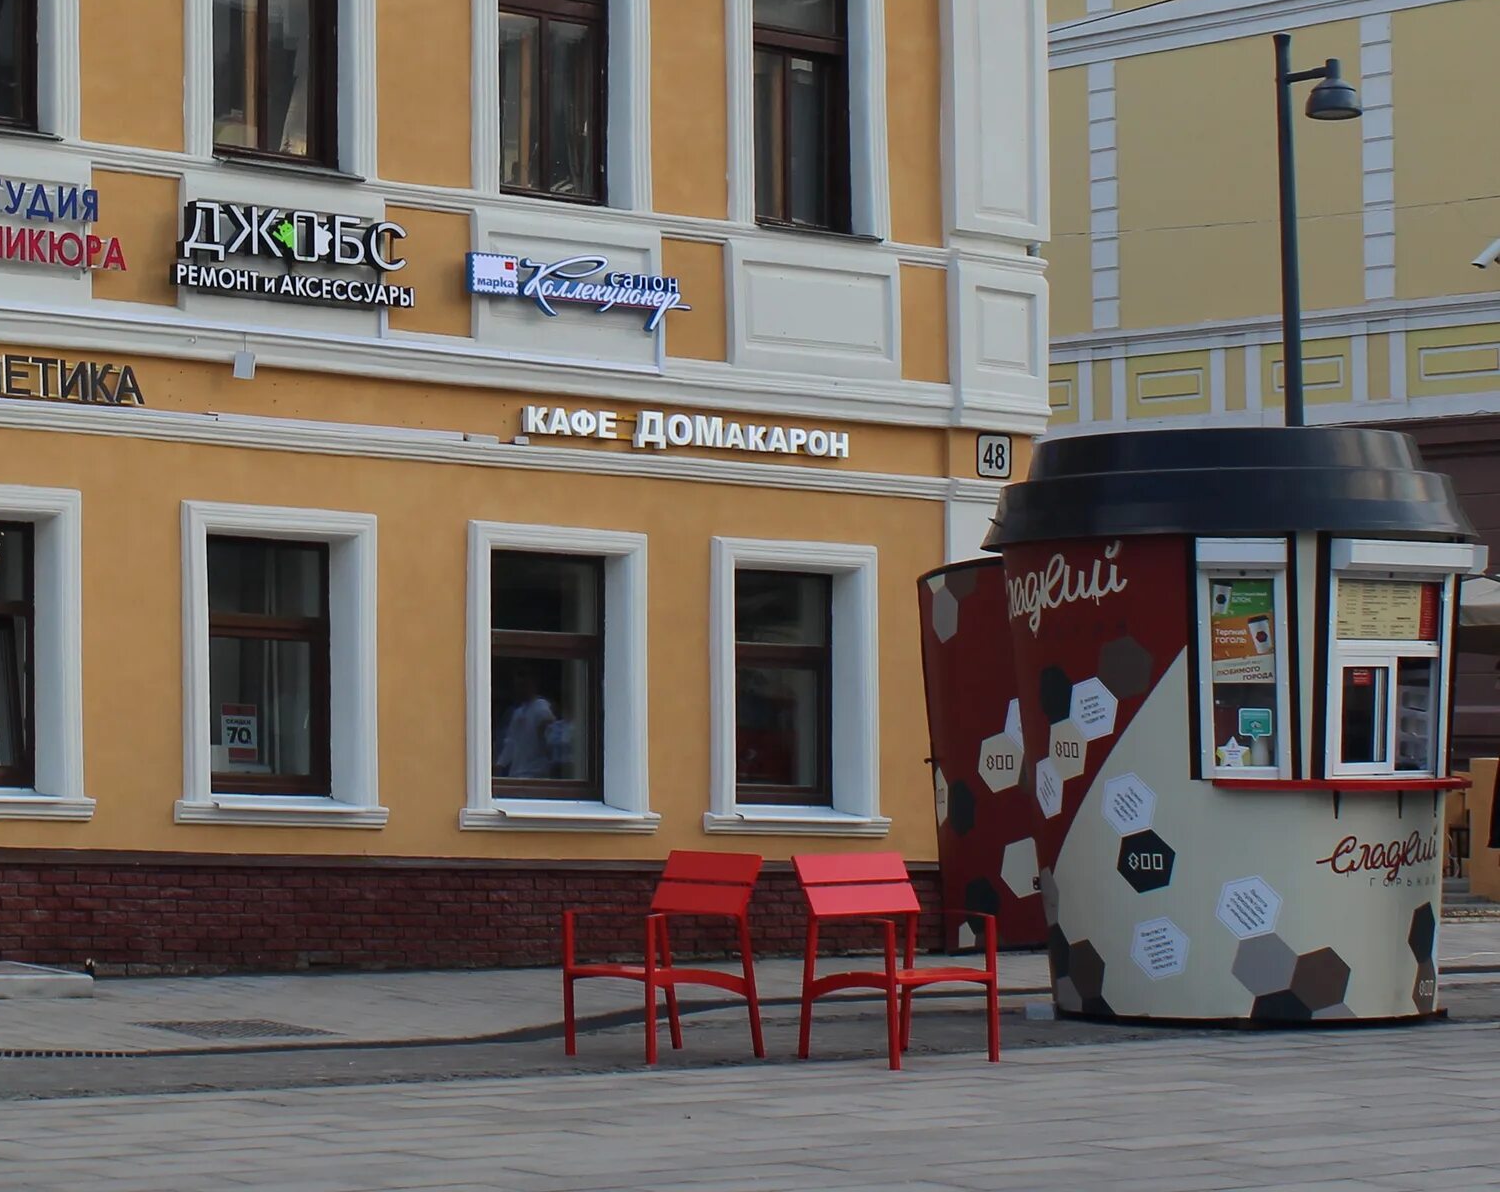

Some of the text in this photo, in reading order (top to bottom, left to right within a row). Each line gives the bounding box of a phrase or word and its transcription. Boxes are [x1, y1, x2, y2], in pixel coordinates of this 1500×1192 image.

[176, 263, 259, 293] РЕМОНТ
[279, 273, 415, 308] АКСЕССУАРЫ
[477, 277, 515, 289] марка
[521, 255, 691, 331] Коллекционер
[610, 272, 679, 292] салон
[525, 405, 618, 439] КАФЕ
[982, 441, 1006, 471] 48
[1004, 540, 1128, 638] ладкий
